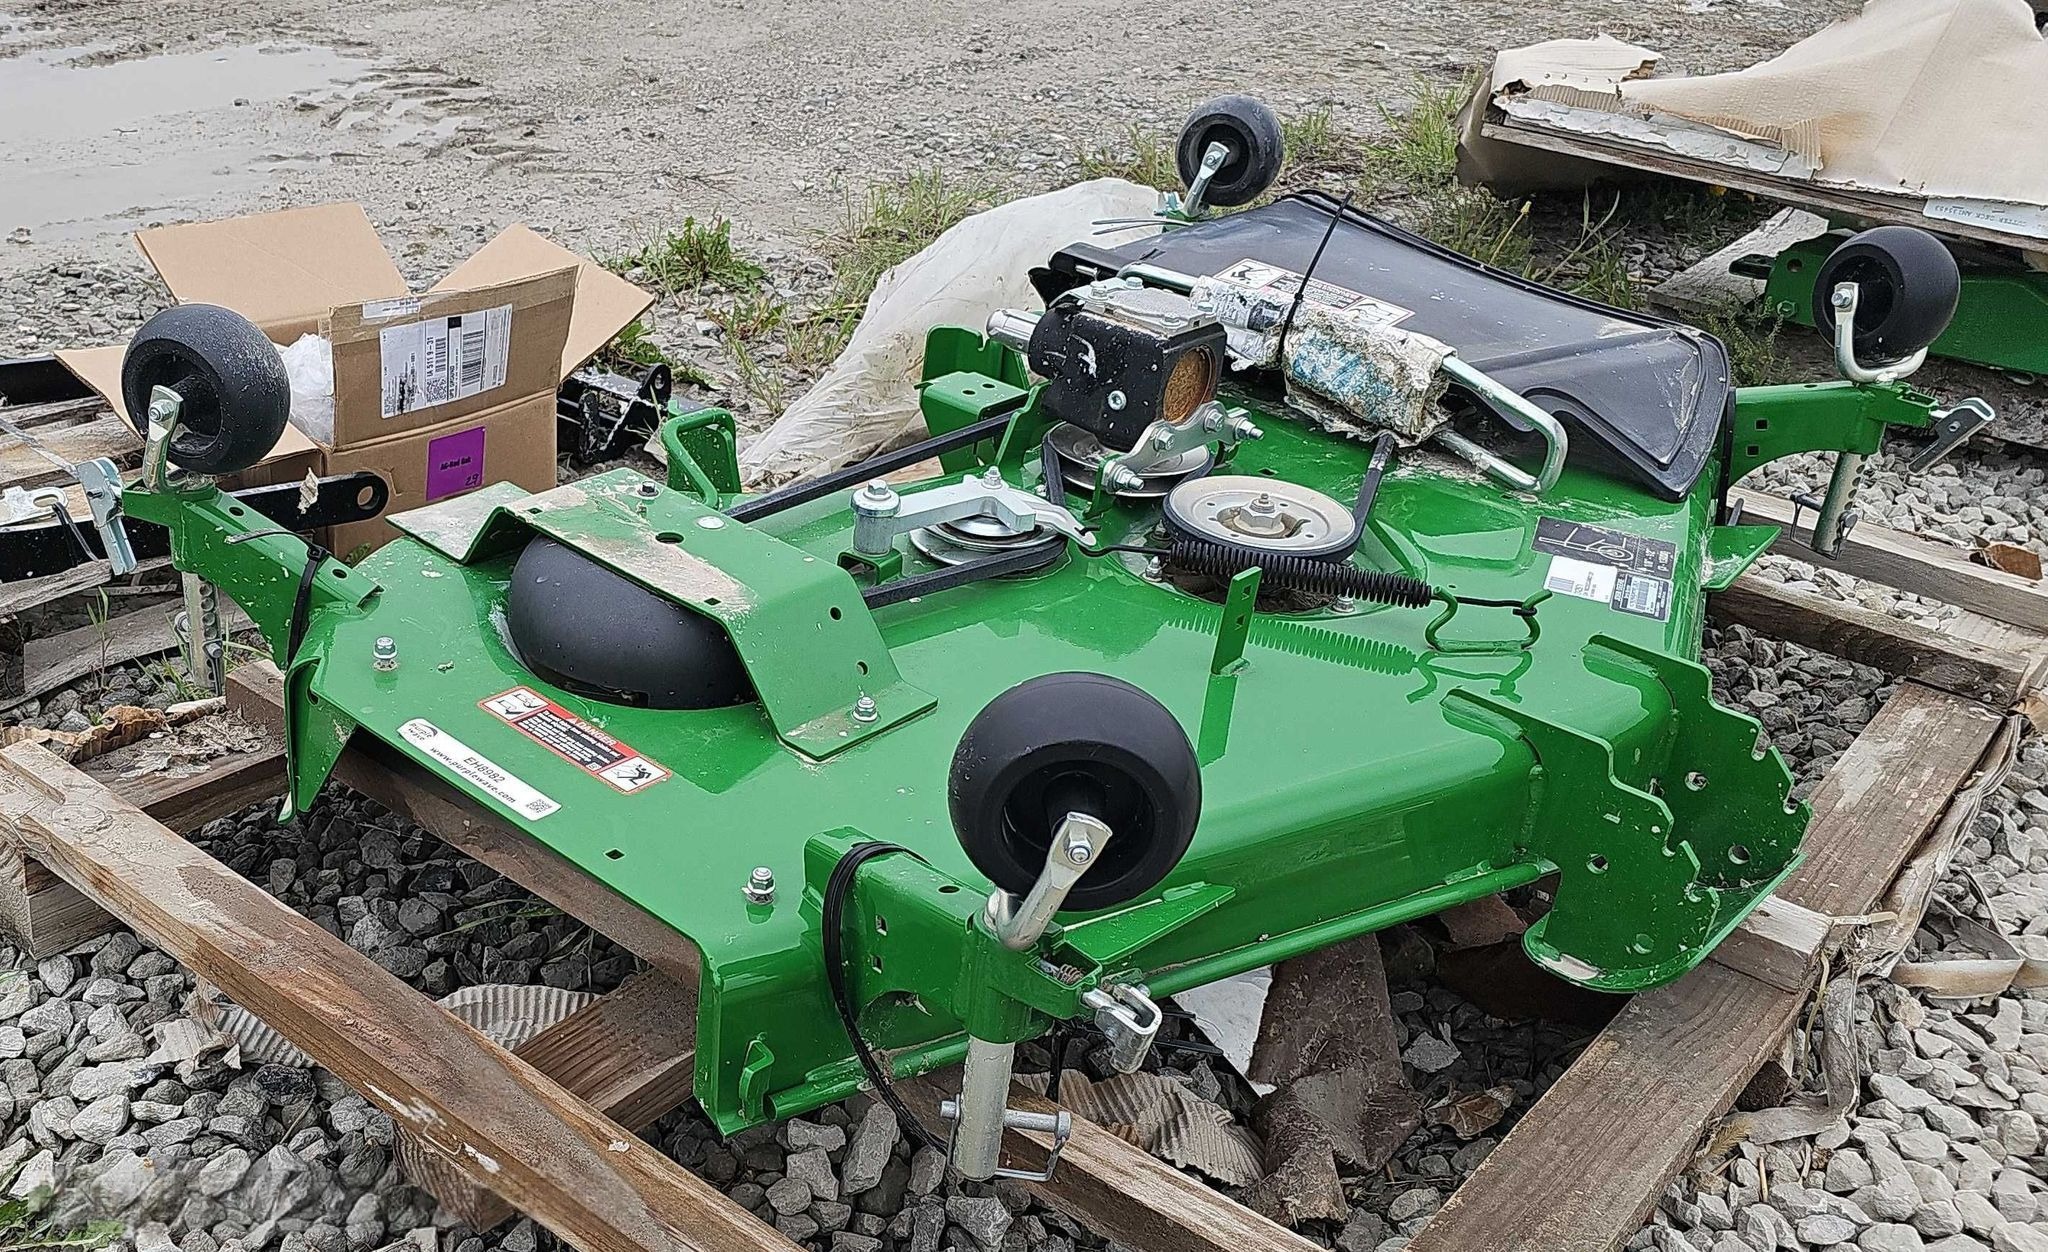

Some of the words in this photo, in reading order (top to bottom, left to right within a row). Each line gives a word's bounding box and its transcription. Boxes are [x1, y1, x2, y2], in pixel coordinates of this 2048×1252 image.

[576, 720, 617, 746] DANGER
[430, 747, 516, 804] www.purplewave.com
[463, 756, 506, 783] EH8982
